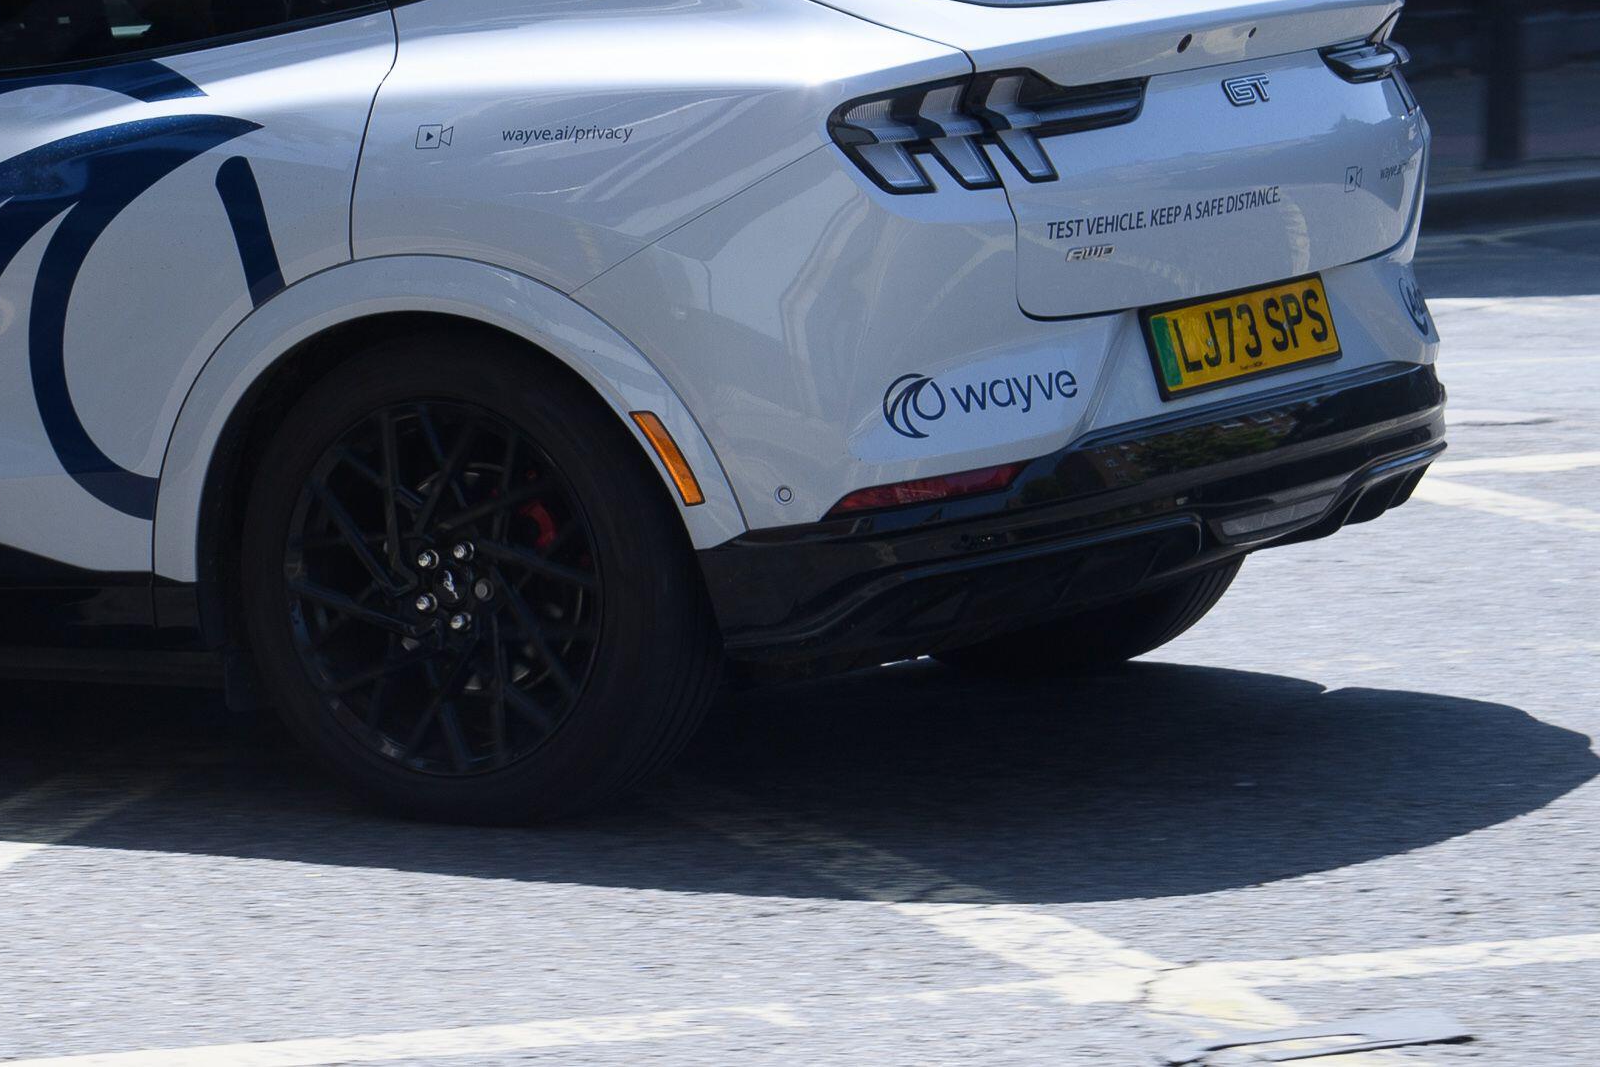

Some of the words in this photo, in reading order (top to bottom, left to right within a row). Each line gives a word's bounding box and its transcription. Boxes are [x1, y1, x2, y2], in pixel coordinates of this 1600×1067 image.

[1221, 73, 1269, 107] GT
[502, 125, 633, 145] wayve.ai/privacy
[1047, 218, 1084, 240] TEST
[1086, 211, 1147, 235] VEHICLE.
[1150, 205, 1182, 227] KEEP
[1183, 203, 1192, 221] A
[1195, 197, 1224, 220] SAFE
[1226, 186, 1281, 214] DISTANCE.
[1172, 303, 1263, 373] LJ73
[1263, 288, 1329, 352] SPS
[950, 370, 1078, 414] wayve
